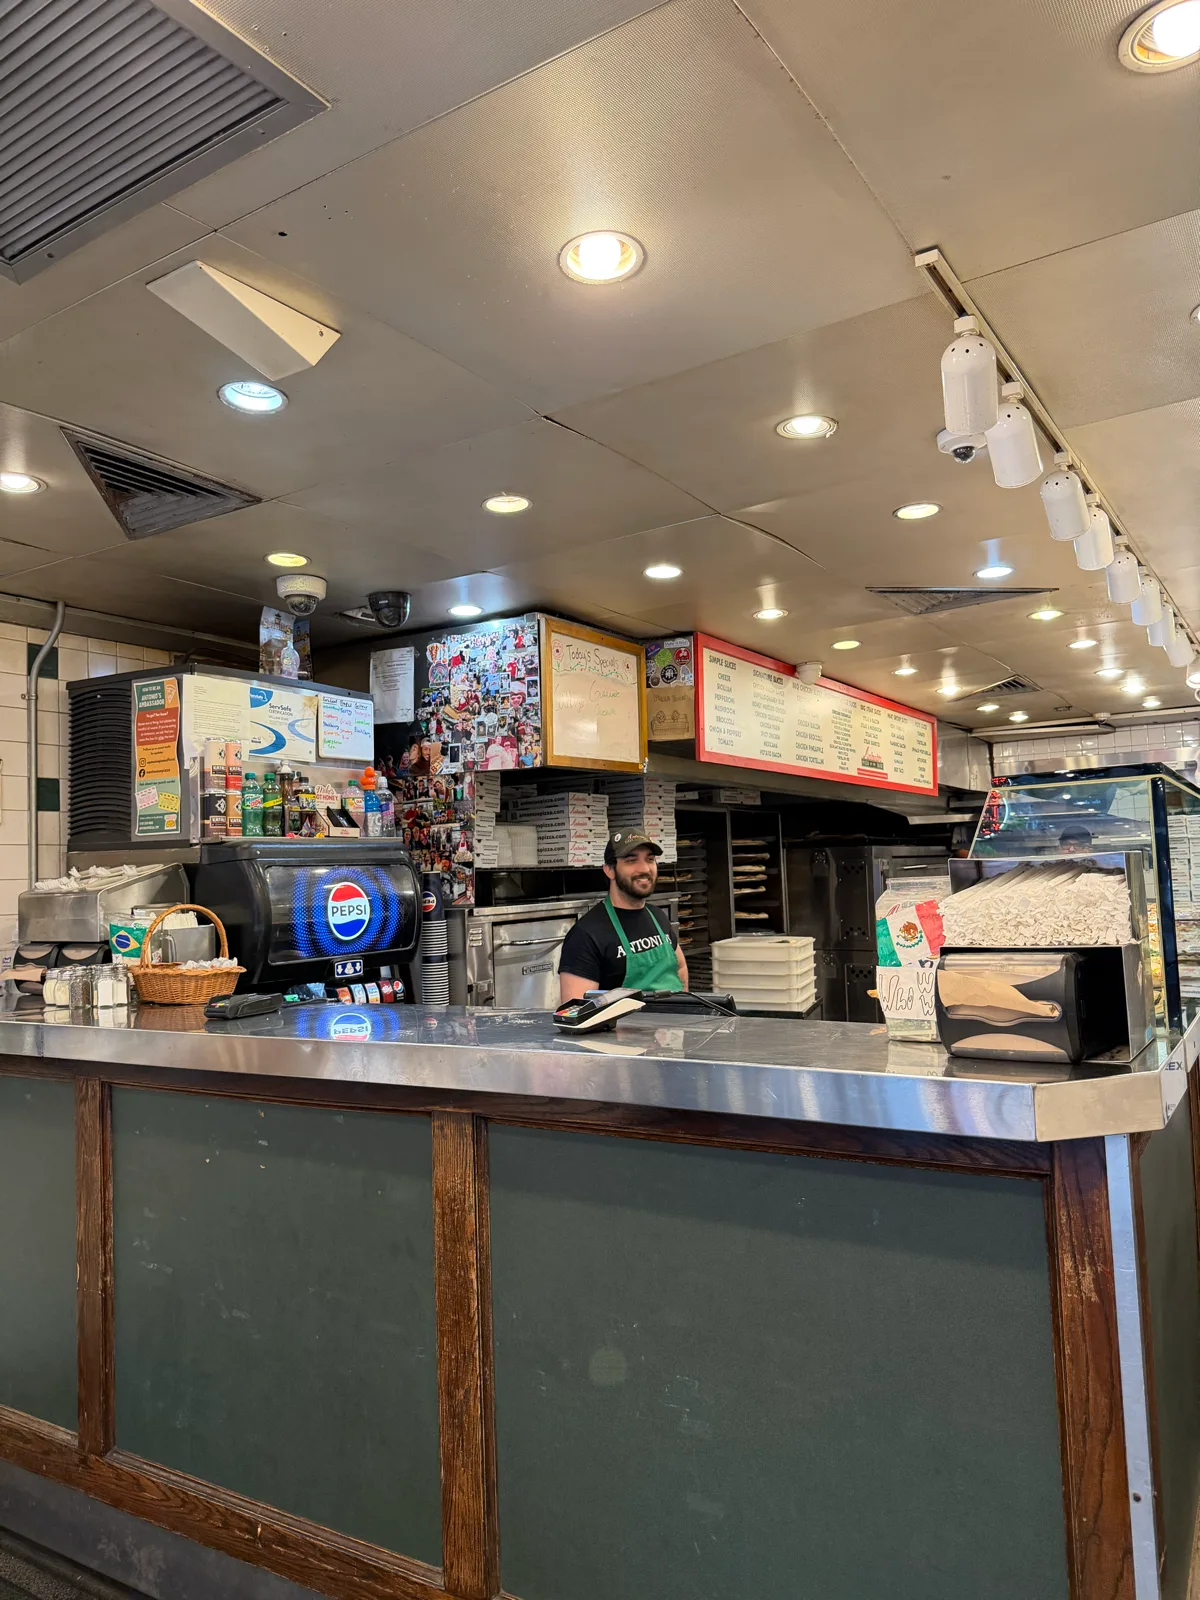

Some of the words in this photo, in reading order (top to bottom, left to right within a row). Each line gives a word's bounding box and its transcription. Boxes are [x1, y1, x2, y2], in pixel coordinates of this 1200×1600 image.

[566, 644, 592, 670] Today's
[594, 648, 619, 674] Specials
[709, 655, 723, 666] SIMPLE
[724, 660, 736, 670] SLICES
[718, 673, 731, 682] CHEESE
[753, 670, 772, 682] SIGNATURE
[773, 675, 783, 685] SLICES
[717, 684, 732, 692] SICILIAN
[139, 699, 164, 708] AMBASSADOR
[715, 694, 735, 704] PEPPERONI
[269, 703, 291, 712] ServSafe
[716, 716, 734, 725] BROCCOLI
[709, 726, 722, 734] ONION
[727, 728, 741, 737] PEPPERS
[718, 738, 734, 746] TOMATO
[796, 754, 808, 762] CHICKEN
[331, 904, 367, 917] PEPSI
